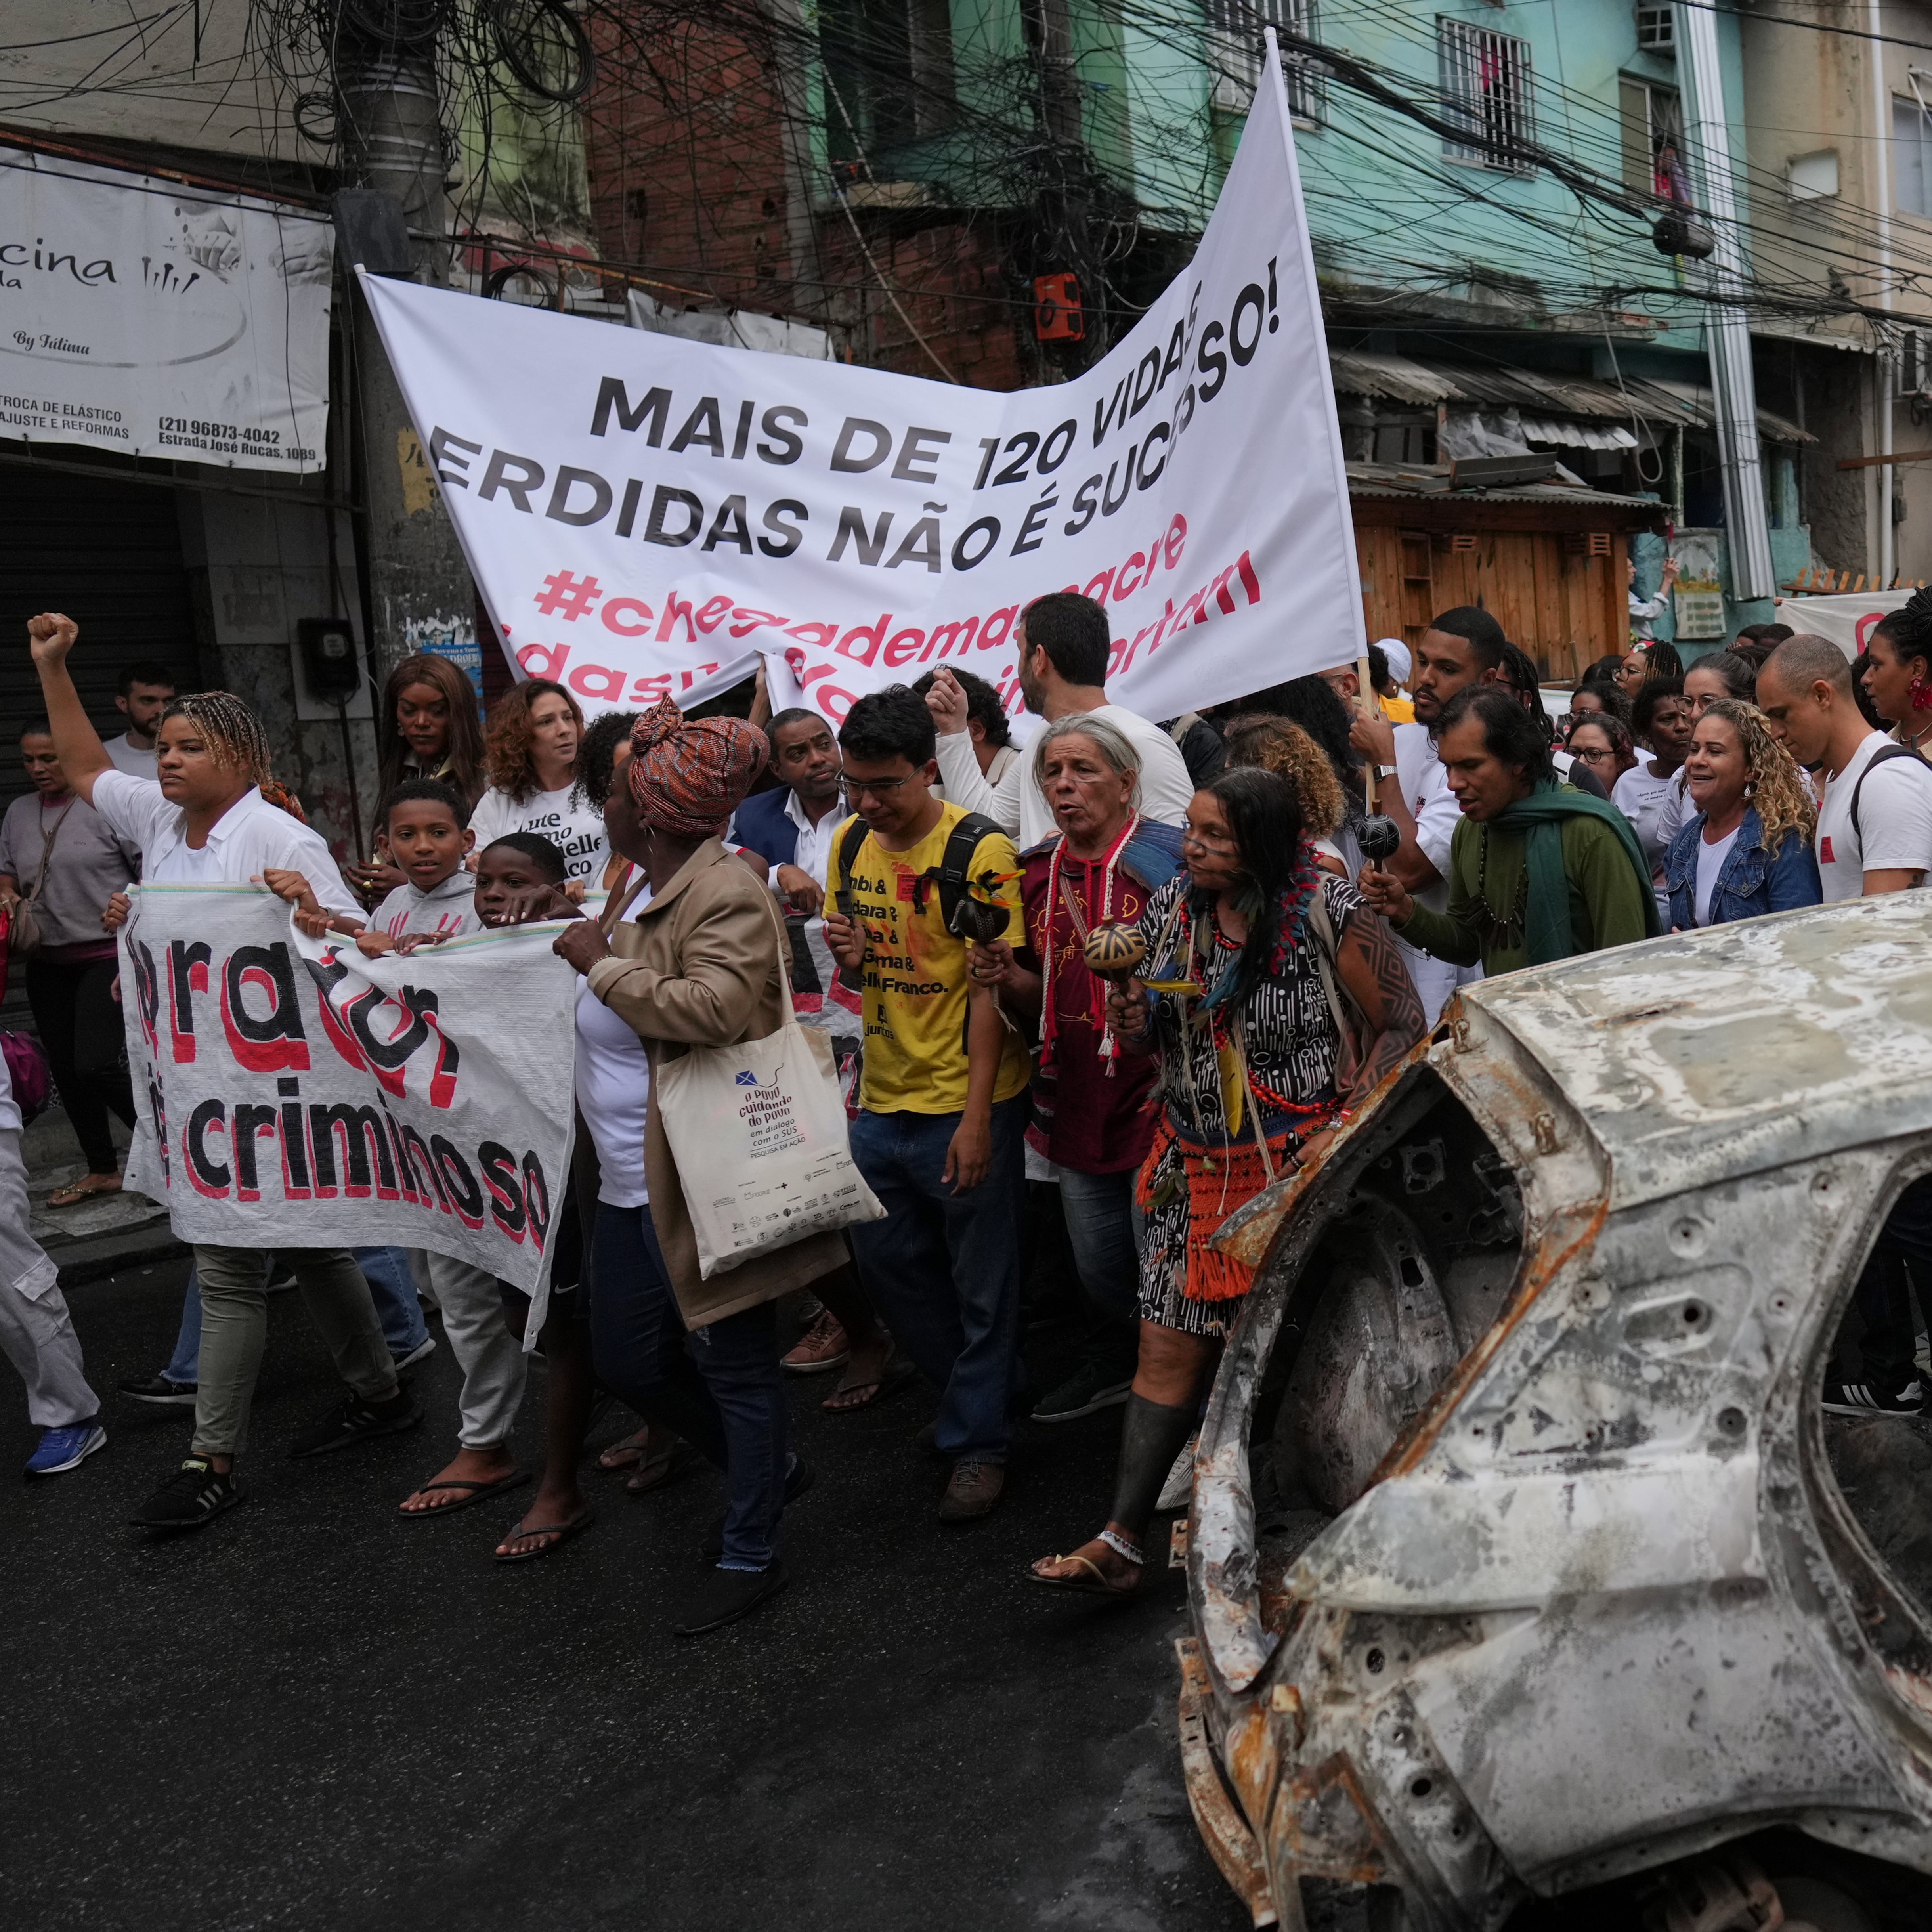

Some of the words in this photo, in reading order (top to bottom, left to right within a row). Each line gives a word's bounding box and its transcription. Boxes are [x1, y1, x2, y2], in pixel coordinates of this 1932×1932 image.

[13, 331, 34, 351] By
[590, 376, 809, 466] MAIS
[830, 417, 952, 485] DE
[973, 418, 1078, 491] 120
[1092, 279, 1202, 449] VIDAS
[43, 401, 59, 413] DE
[63, 403, 122, 422] ELÁSTICO
[0, 411, 46, 428] AJUSTE
[50, 418, 58, 429] E
[62, 419, 130, 439] REFORMAS
[159, 416, 187, 433] (21)
[191, 420, 280, 444] 96873-4042
[159, 432, 207, 449] Estrada
[210, 438, 238, 453] José
[826, 501, 1001, 573] NÃO
[1009, 480, 1059, 558] É
[533, 512, 1189, 668] #chegademaacre
[875, 879, 886, 894] &
[905, 956, 915, 972] &
[882, 977, 948, 995] Franco.
[865, 1022, 894, 1040] juntos
[739, 1096, 792, 1118] cuidando
[749, 1114, 762, 1127] do
[765, 1118, 795, 1133] diálogo
[753, 1137, 771, 1147] com
[782, 1126, 798, 1138] SUS
[750, 1147, 779, 1159] PESQUISA
[789, 1137, 806, 1147] AÇÃO
[182, 1076, 550, 1258] criminoso
